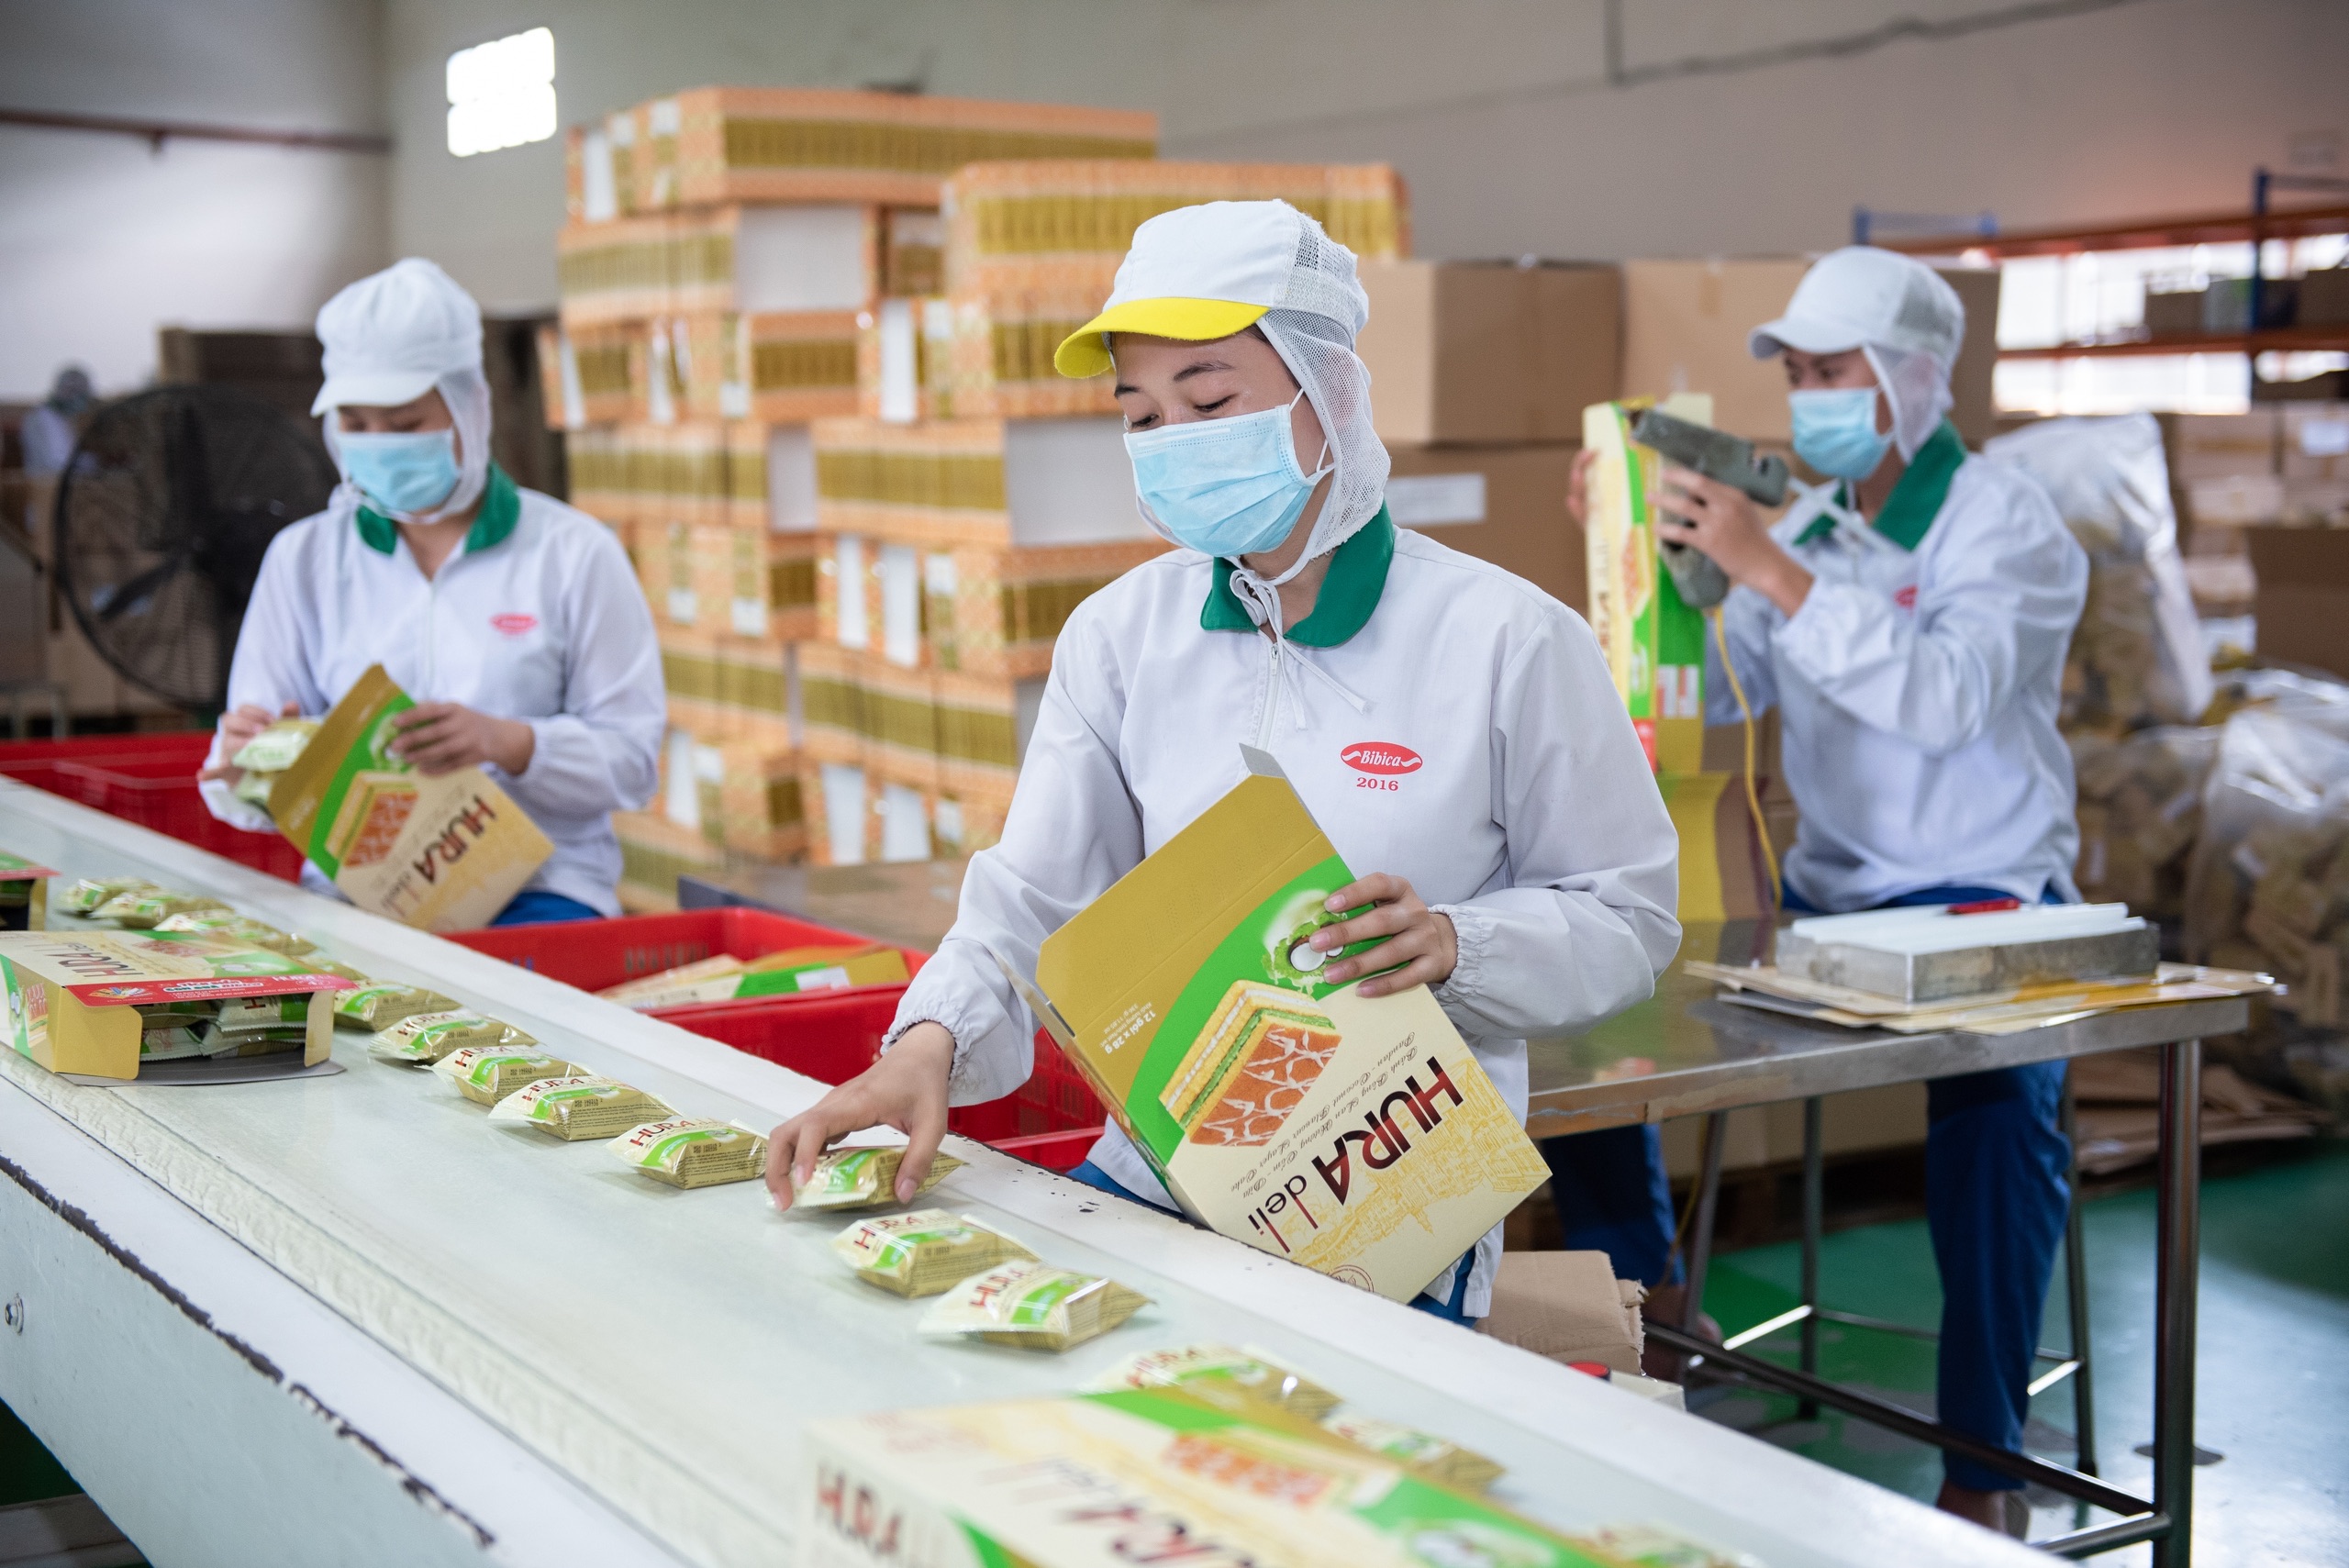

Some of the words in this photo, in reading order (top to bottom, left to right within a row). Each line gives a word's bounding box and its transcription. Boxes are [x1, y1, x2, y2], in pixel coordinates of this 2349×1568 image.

[1360, 750, 1402, 767] Bibica
[1356, 777, 1398, 791] 2016
[413, 794, 496, 884] HURA
[47, 952, 144, 977] HURA
[1130, 1018, 1144, 1036] gói
[1143, 1010, 1156, 1022] 12
[1112, 1036, 1125, 1050] 28
[1122, 1030, 1130, 1039] x
[1104, 1044, 1113, 1054] g
[1377, 1031, 1415, 1066] Pandan
[1391, 1046, 1418, 1073] Bánh
[521, 1078, 584, 1102] HURA
[1332, 1072, 1371, 1107] Coconut
[1361, 1072, 1388, 1097] Bông
[1335, 1096, 1360, 1119] Lan
[629, 1120, 696, 1146] HURA
[1311, 1056, 1464, 1206] HURA
[1259, 1139, 1290, 1168] Layer
[1230, 1168, 1258, 1192] Cake
[1248, 1175, 1319, 1253] deli
